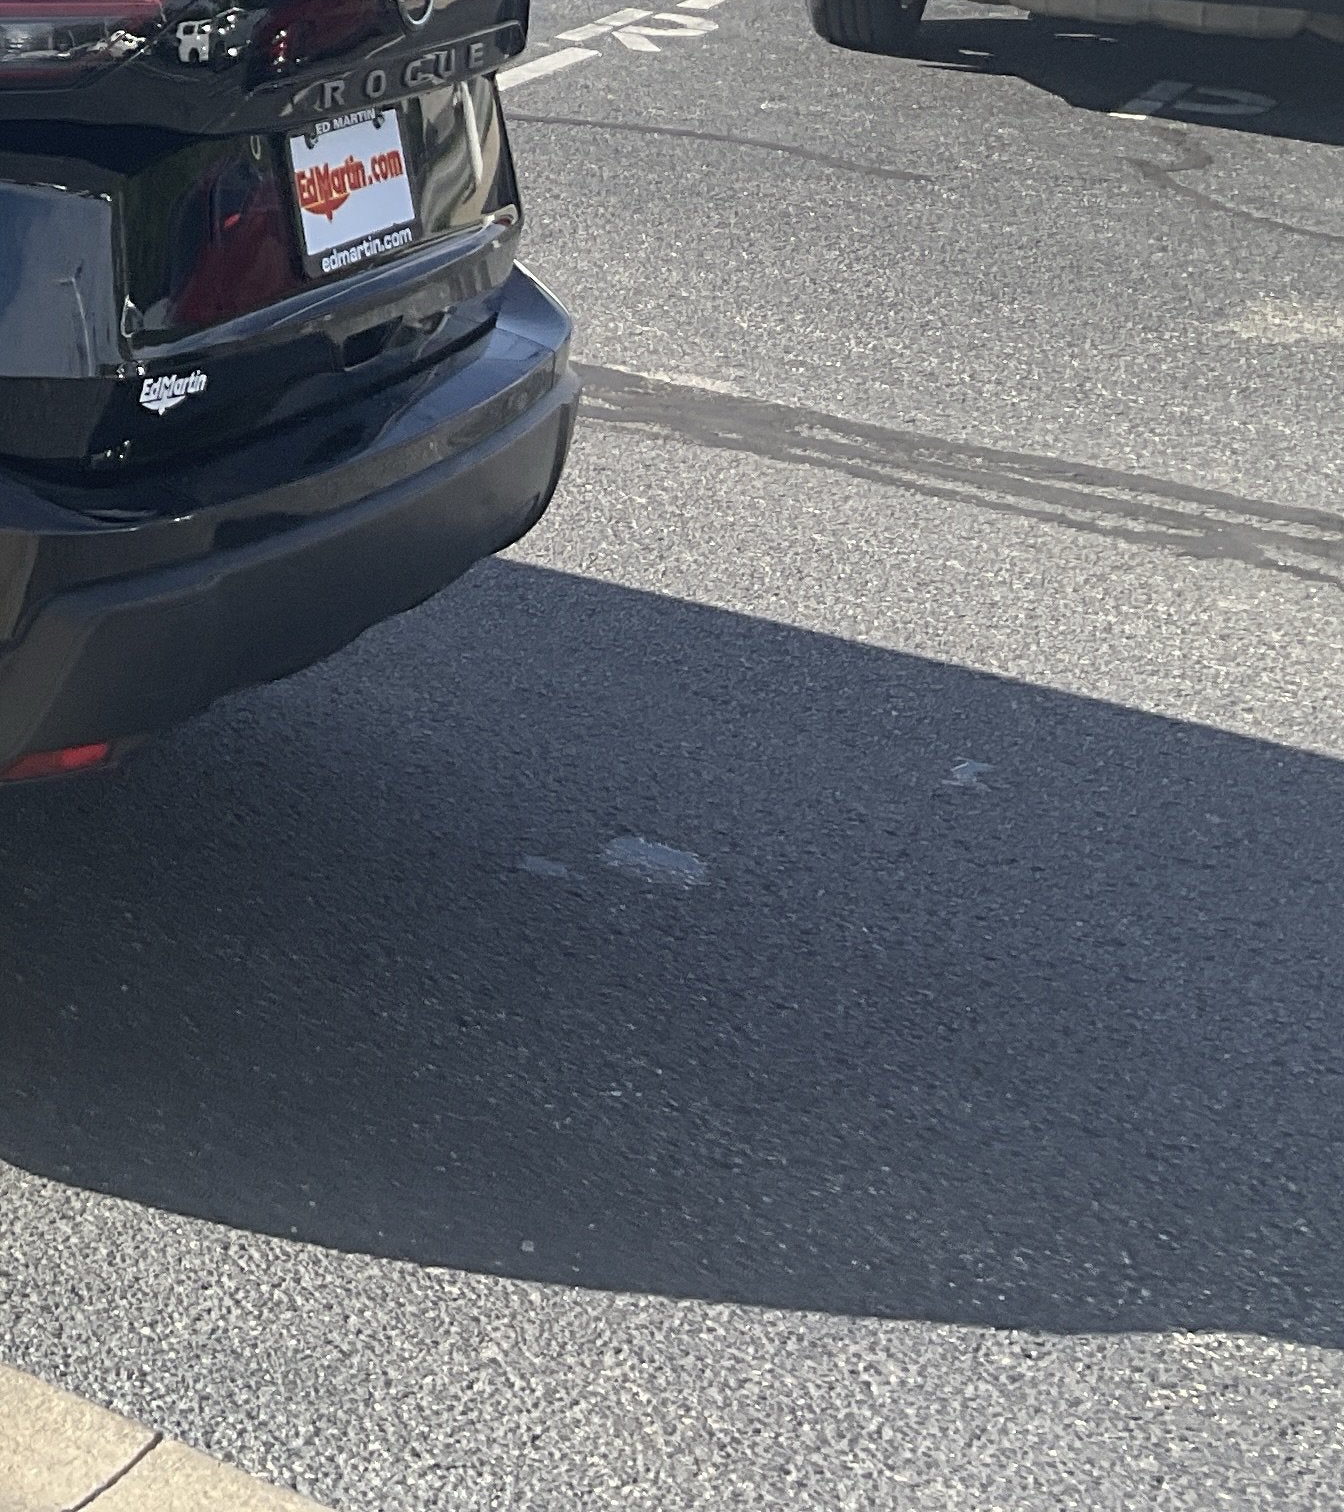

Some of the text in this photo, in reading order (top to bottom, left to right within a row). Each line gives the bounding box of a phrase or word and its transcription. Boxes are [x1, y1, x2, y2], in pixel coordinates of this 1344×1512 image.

[323, 43, 485, 110] ROGUE
[315, 107, 377, 134] ED MARTIN
[294, 149, 404, 208] EdMartin.com
[321, 226, 412, 273] edmartin.com
[139, 369, 208, 403] EdMartin
